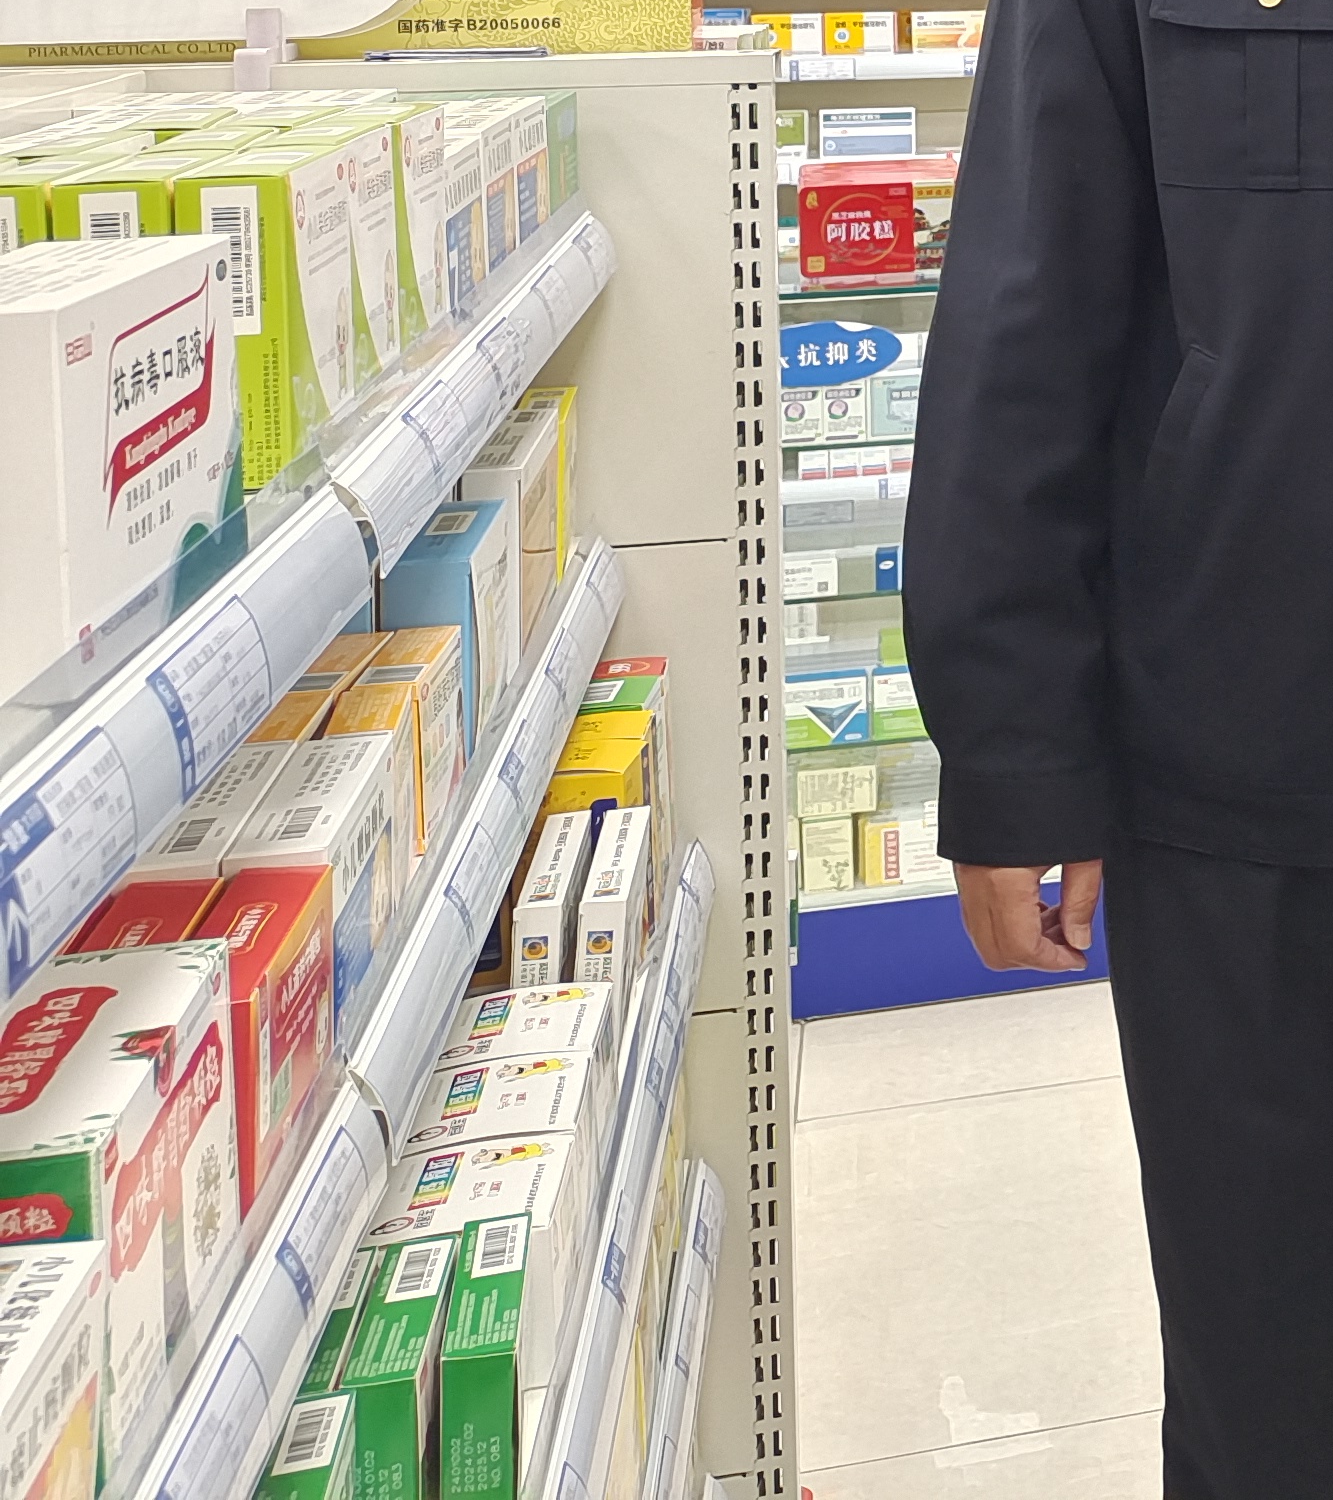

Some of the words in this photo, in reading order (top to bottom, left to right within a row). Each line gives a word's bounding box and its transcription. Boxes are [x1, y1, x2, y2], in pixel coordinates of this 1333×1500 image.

[396, 14, 562, 36] 国药准字B20050066
[28, 43, 170, 59] PHARMACEUTICAL
[825, 218, 895, 244] 阿胶糕
[796, 337, 878, 367] 抗抑类
[111, 325, 207, 417] 抗病毒口服液
